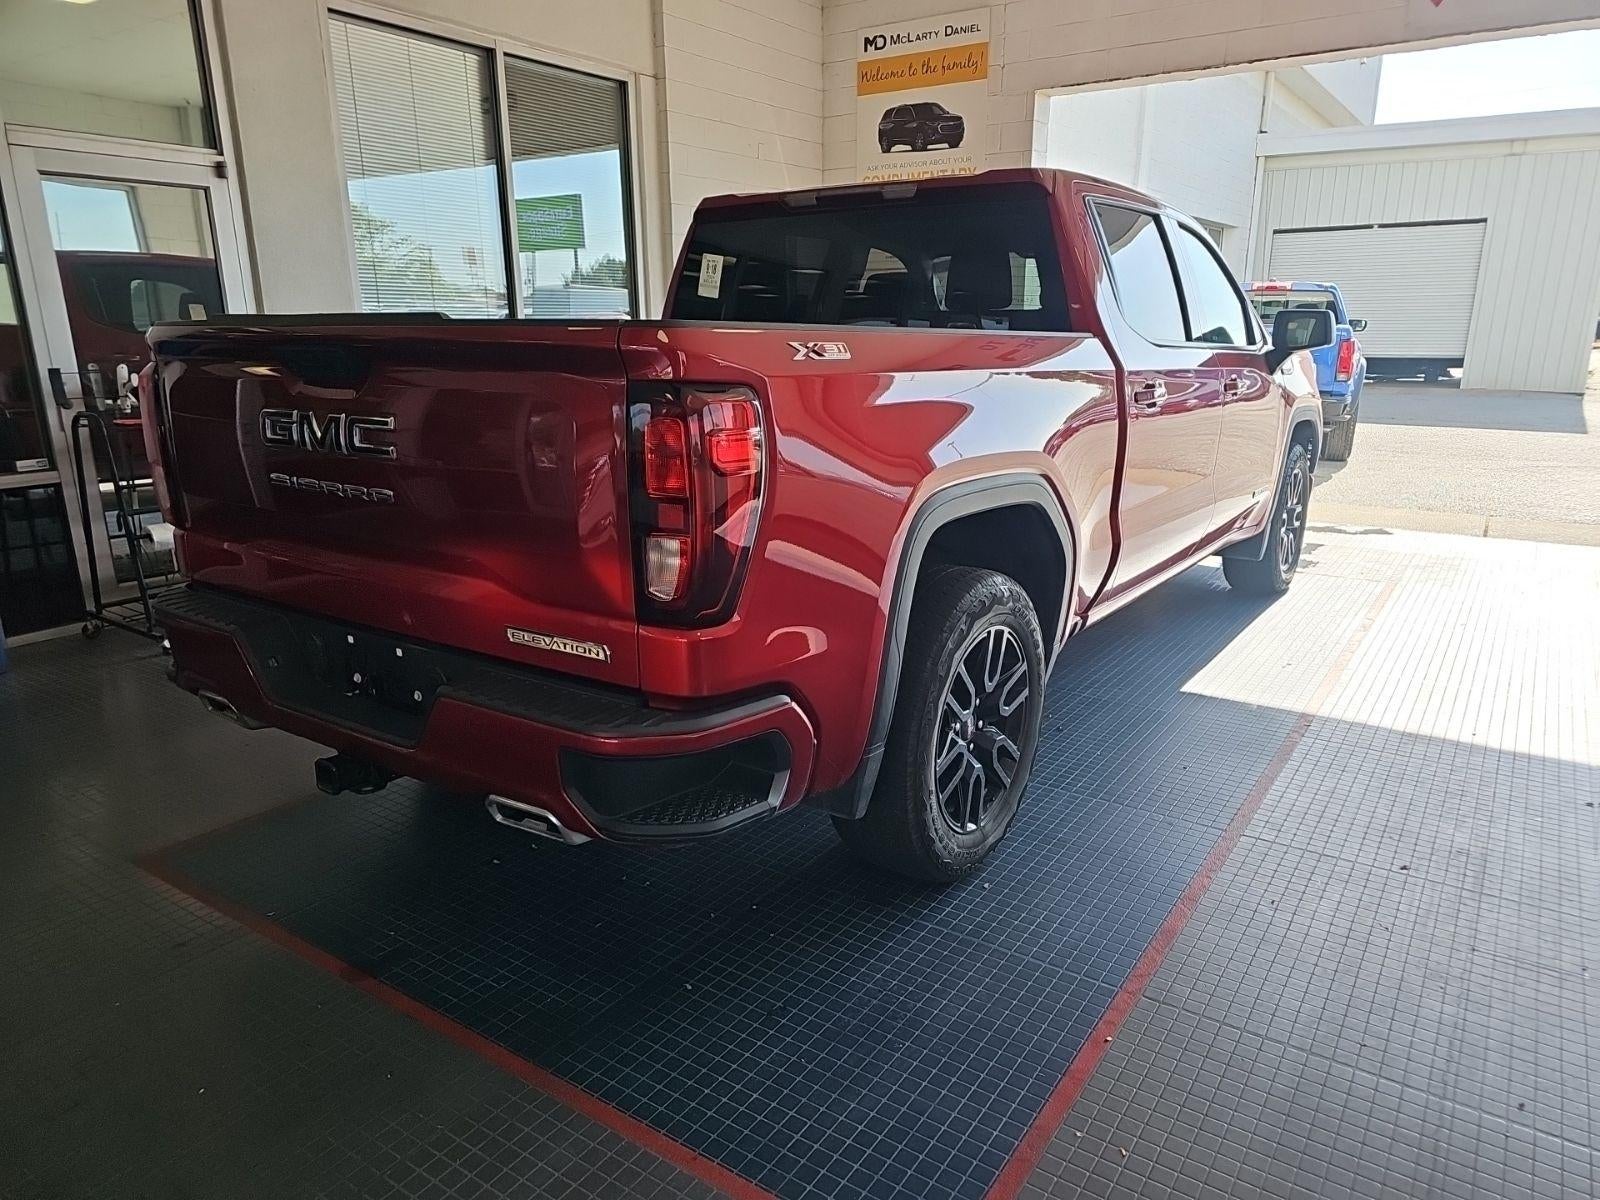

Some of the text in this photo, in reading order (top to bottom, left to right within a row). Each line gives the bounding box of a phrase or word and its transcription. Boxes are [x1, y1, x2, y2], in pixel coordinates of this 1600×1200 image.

[861, 51, 984, 83] Welcome to the family!
[899, 160, 928, 169] ADVISOR
[928, 157, 952, 166] ABOUT
[953, 155, 973, 164] YOUR
[260, 409, 397, 459] GMC
[270, 472, 396, 503] SIERRA
[511, 631, 600, 658] ELEVATION
